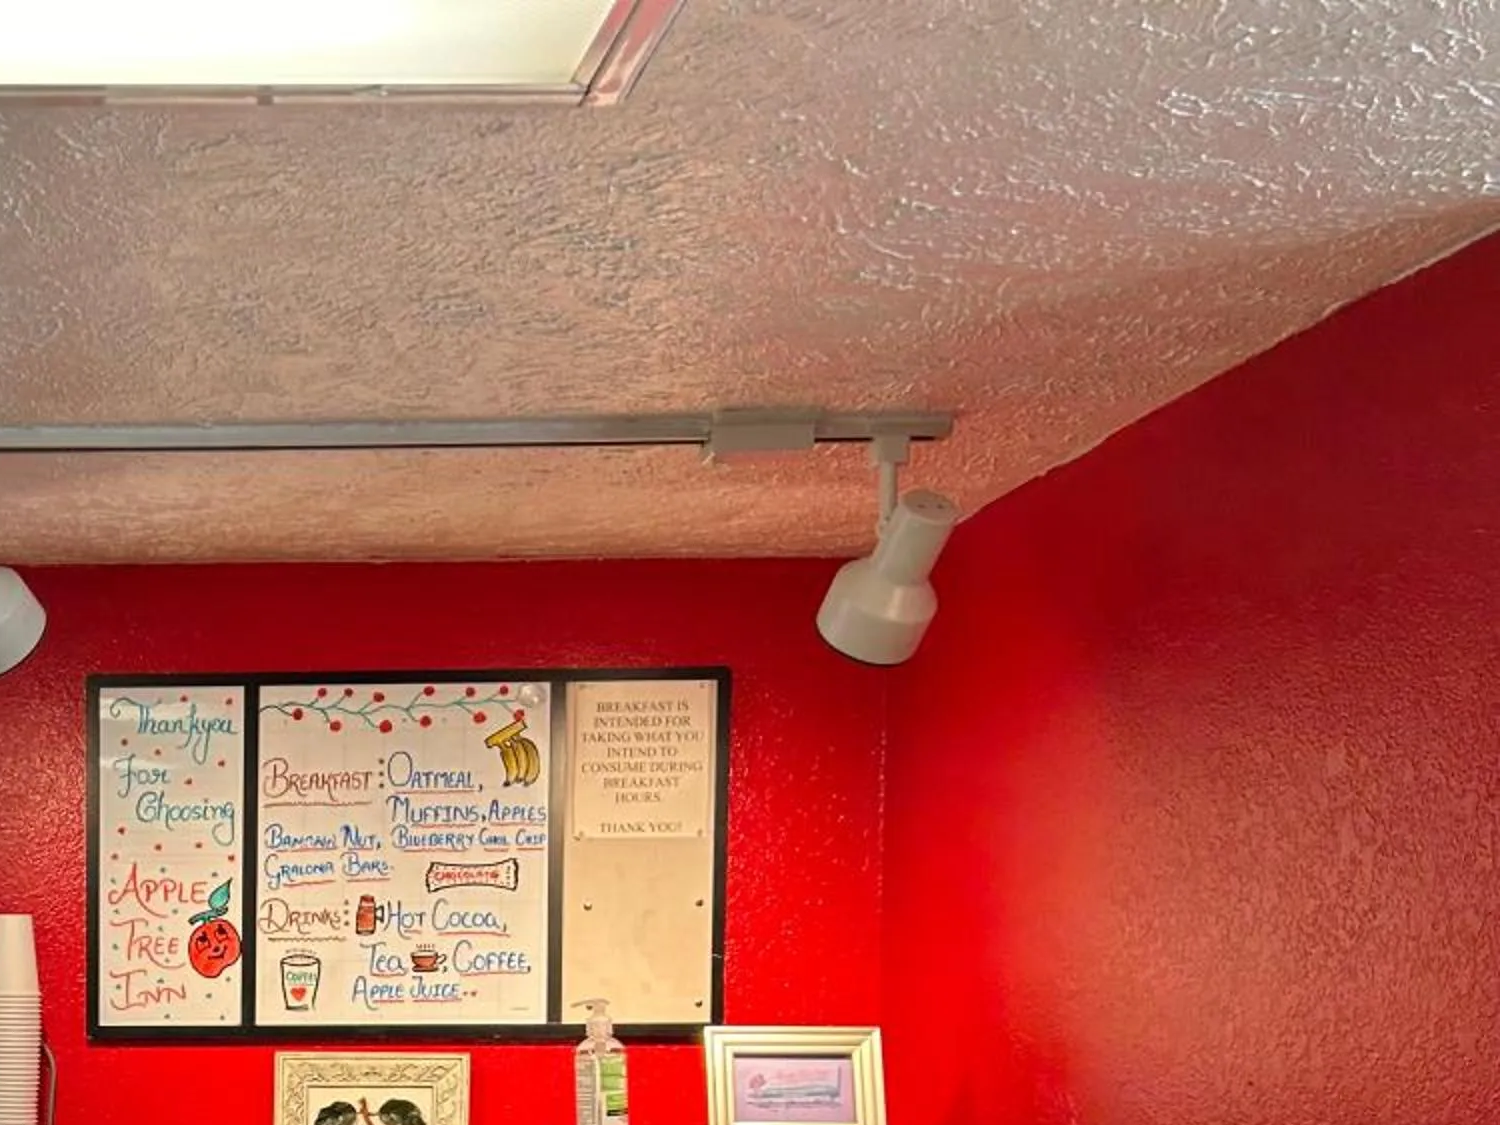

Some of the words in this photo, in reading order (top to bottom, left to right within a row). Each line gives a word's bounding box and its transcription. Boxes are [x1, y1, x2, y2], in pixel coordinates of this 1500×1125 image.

[596, 701, 673, 713] BREAKFAST
[677, 700, 689, 711] IS
[594, 716, 662, 728] INTENDED
[666, 716, 691, 727] FOR
[582, 732, 631, 743] TAKING
[634, 732, 672, 743] WHAT
[675, 731, 704, 742] YOU
[607, 747, 656, 758] INTEND
[661, 747, 677, 757] TO
[581, 762, 647, 773] CONSUME
[650, 761, 703, 773] DURING
[603, 776, 679, 789] BREAKFAST
[136, 791, 235, 846] Choosing
[600, 822, 645, 833] THANK
[647, 821, 683, 833] YOU!
[108, 862, 207, 918] APPLE
[383, 899, 427, 939] HOT
[110, 919, 185, 969] TREE
[110, 970, 186, 1011] INN
